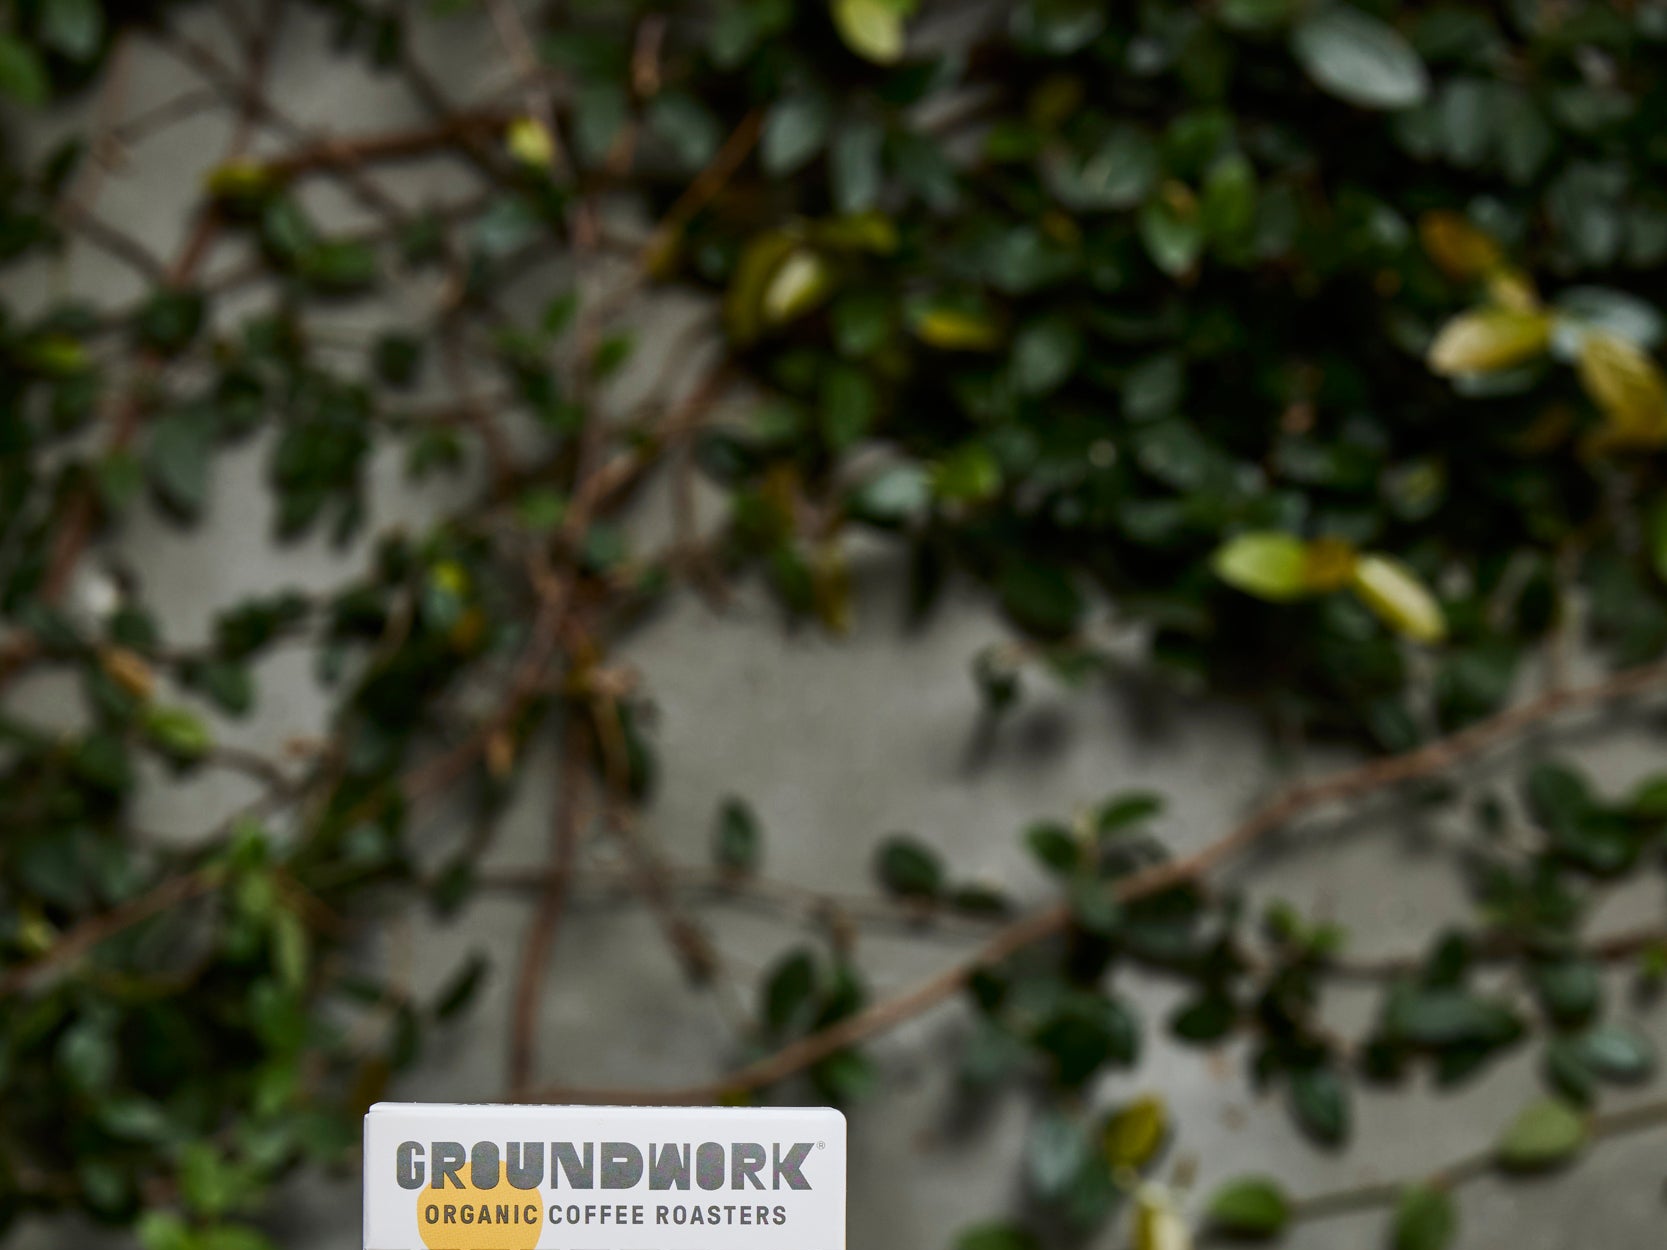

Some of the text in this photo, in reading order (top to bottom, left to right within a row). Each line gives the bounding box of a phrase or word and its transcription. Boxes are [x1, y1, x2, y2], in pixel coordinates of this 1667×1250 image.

[425, 1204, 787, 1225] ORGANIC COFFEE ROASTERS
